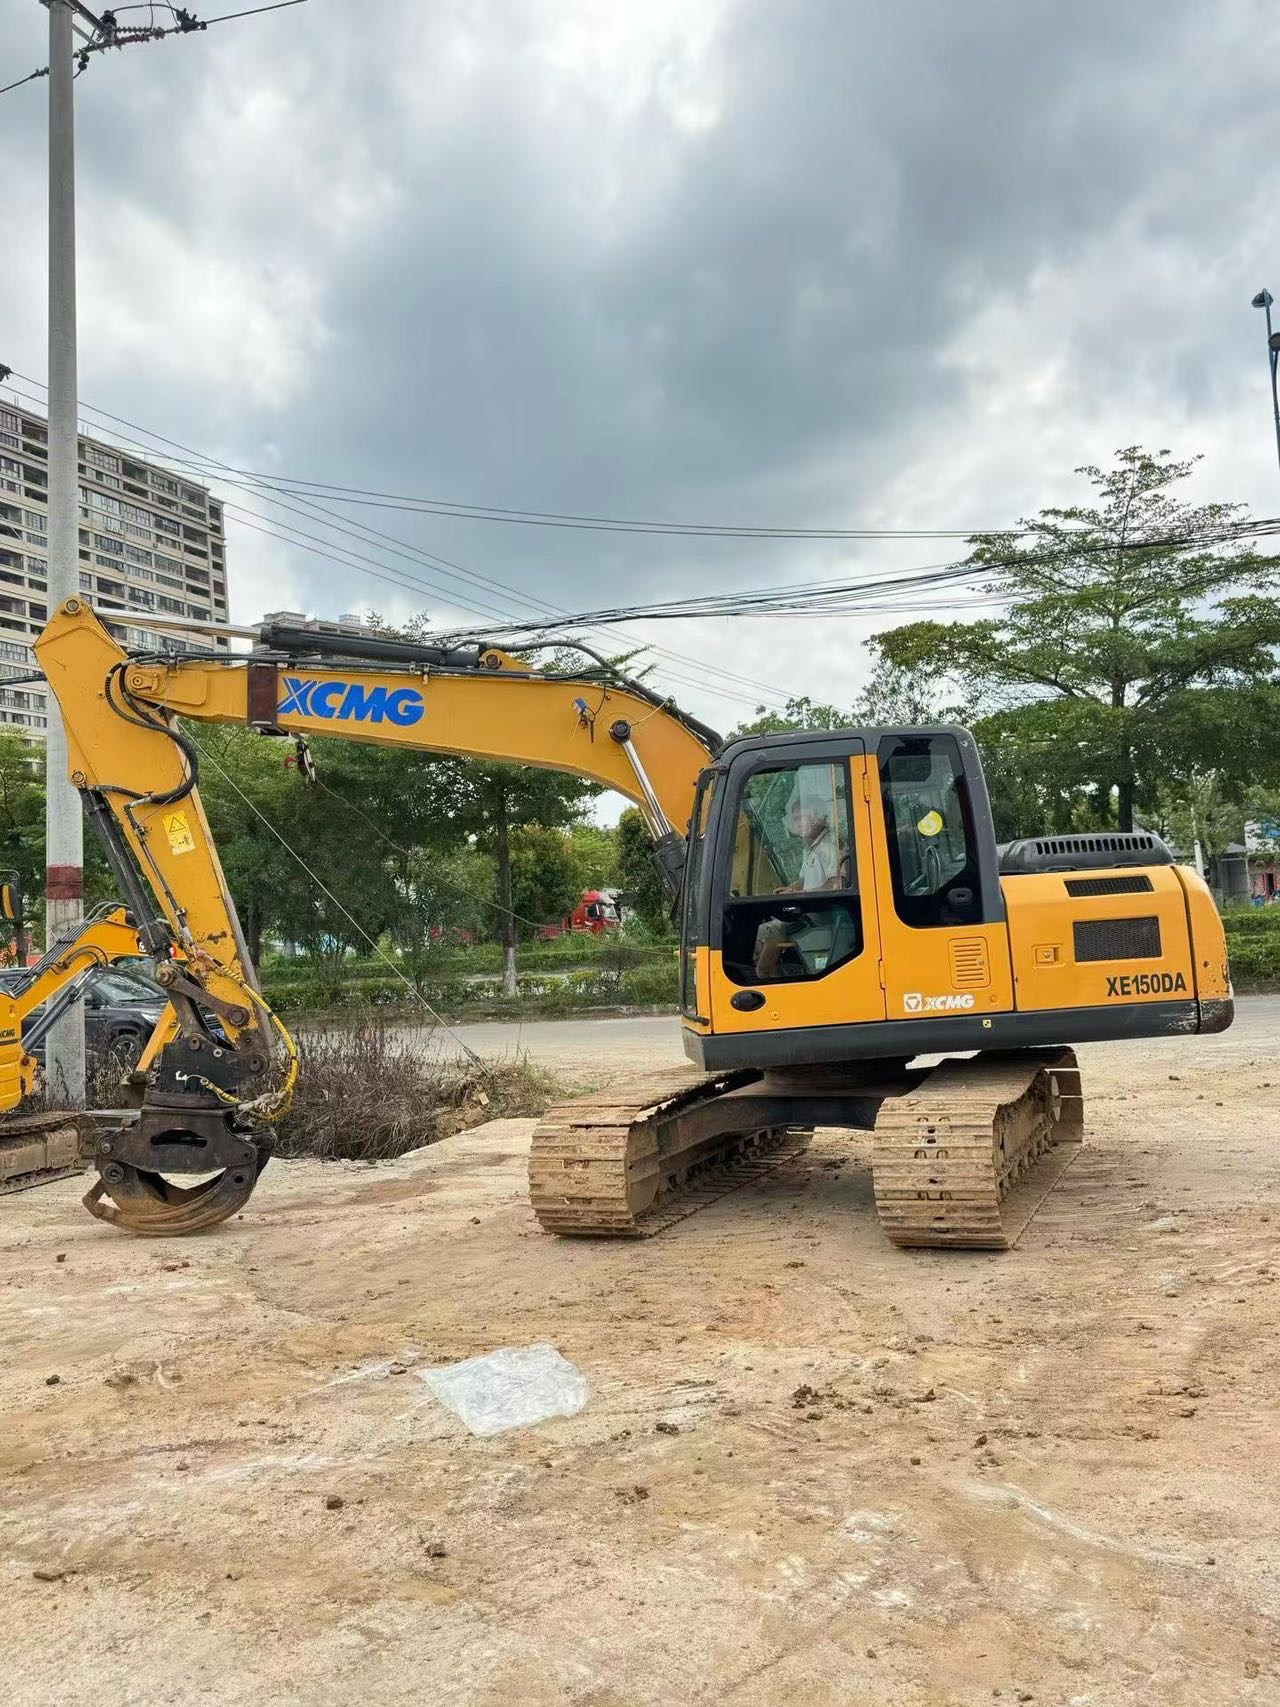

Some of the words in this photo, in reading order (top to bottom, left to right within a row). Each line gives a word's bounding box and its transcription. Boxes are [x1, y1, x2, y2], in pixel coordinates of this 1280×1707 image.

[277, 677, 425, 726] XCMG
[1106, 972, 1187, 997] XE150DA
[923, 994, 975, 1011] XCMG
